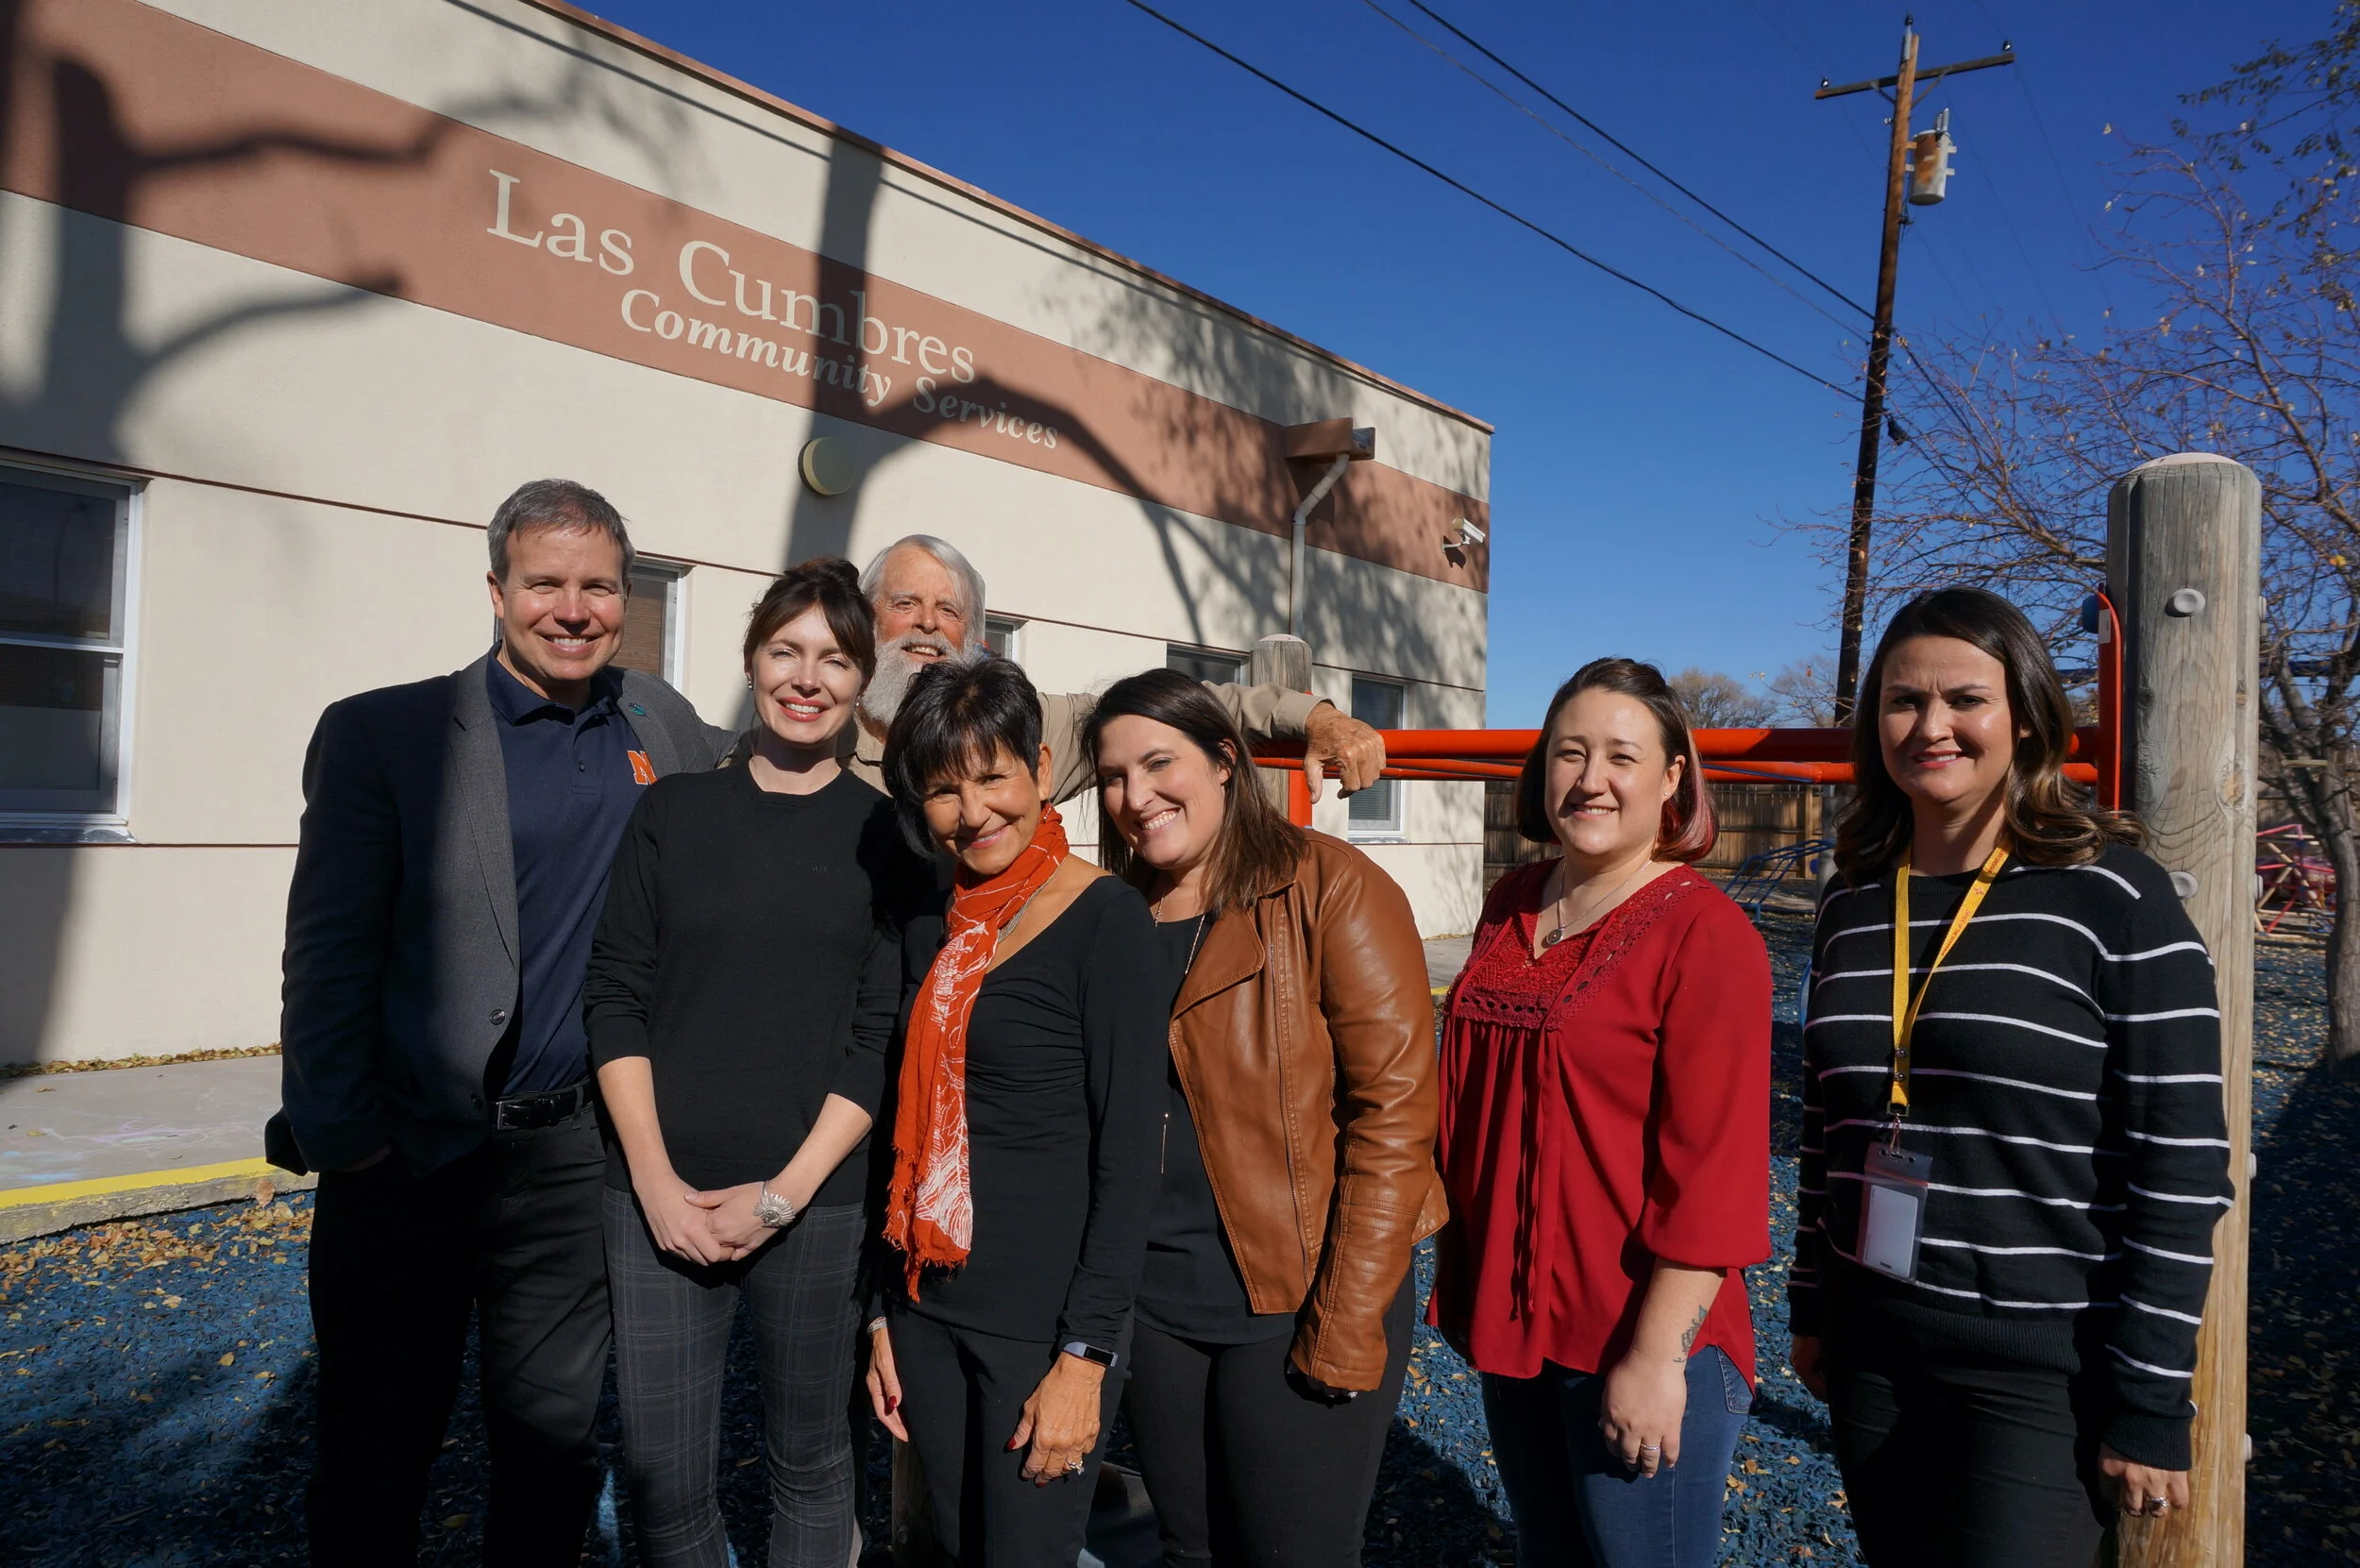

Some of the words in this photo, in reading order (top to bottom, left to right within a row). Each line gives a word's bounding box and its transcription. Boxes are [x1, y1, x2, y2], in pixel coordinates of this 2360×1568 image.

[486, 169, 634, 276] Las
[678, 239, 976, 383] Cumbres
[620, 288, 892, 408] Community
[912, 376, 1059, 450] Services
